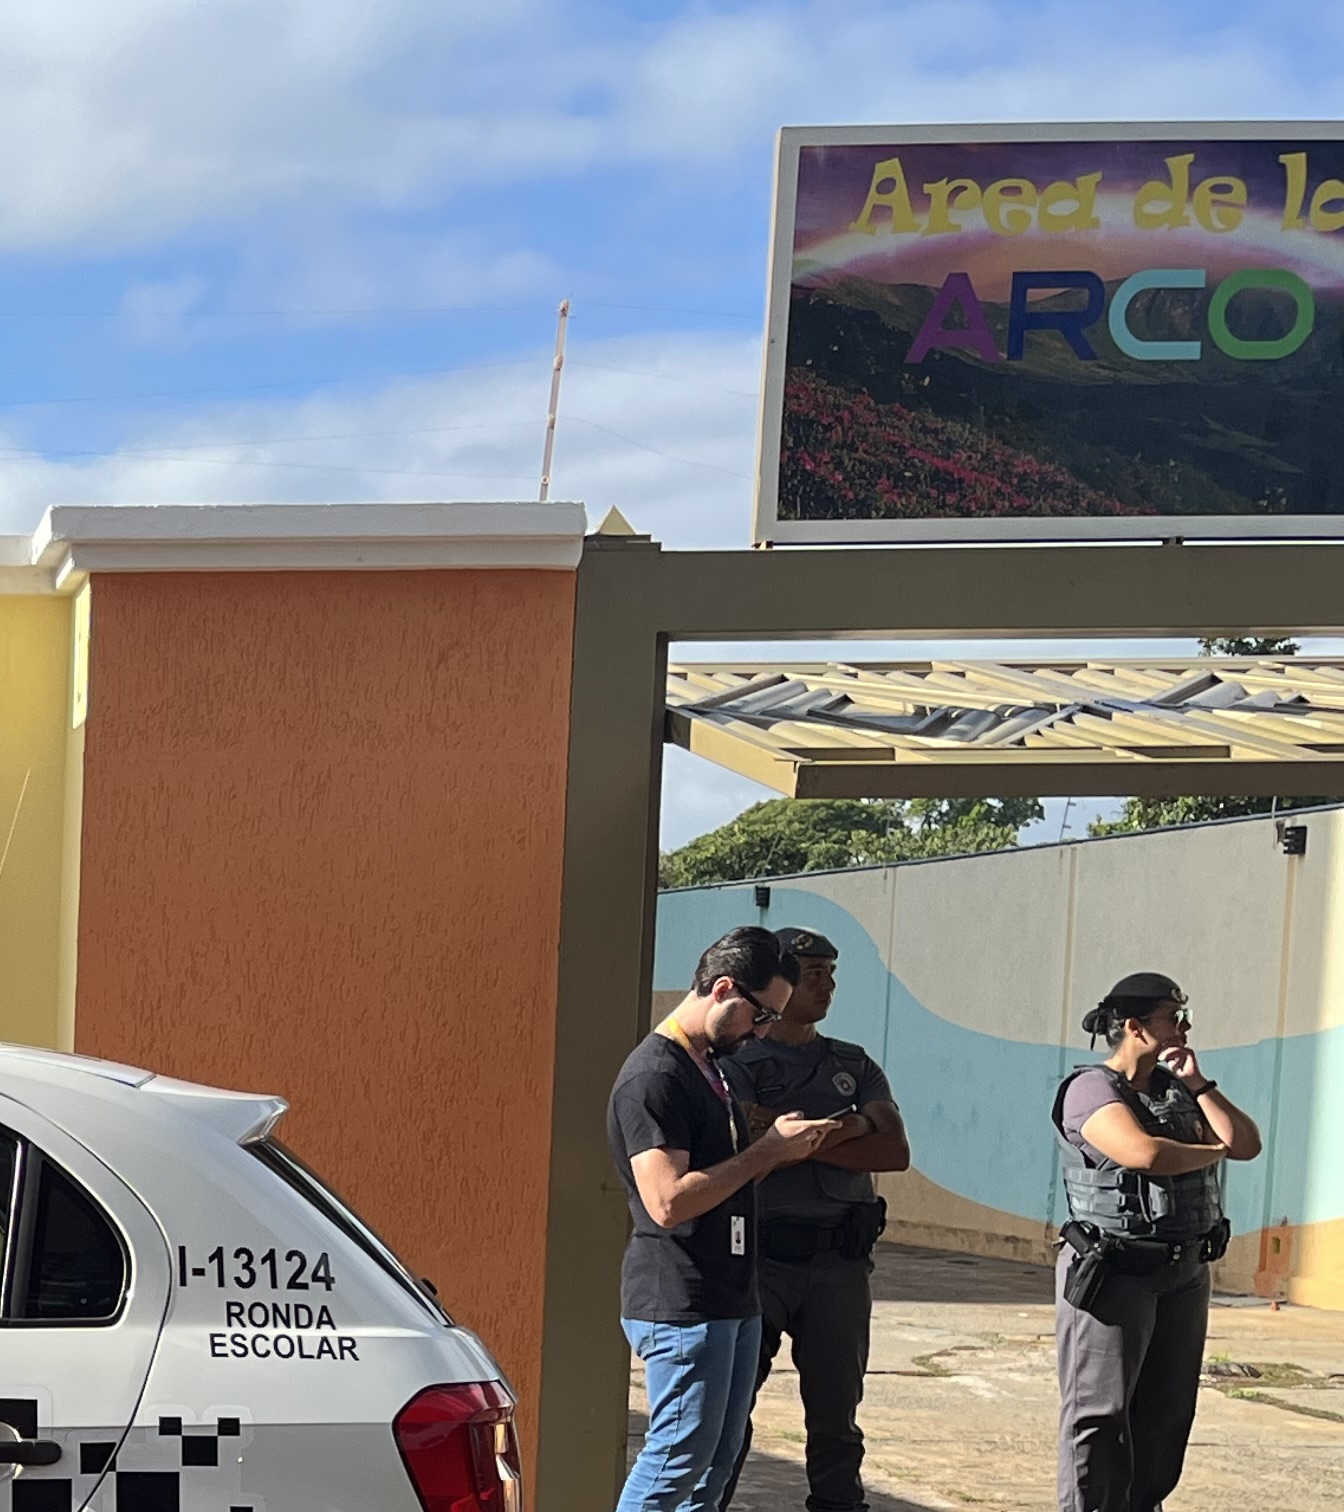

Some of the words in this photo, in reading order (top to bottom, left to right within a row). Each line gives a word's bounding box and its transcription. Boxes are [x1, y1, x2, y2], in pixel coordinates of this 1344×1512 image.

[849, 157, 1103, 236] Area
[1133, 153, 1247, 232] de
[905, 268, 1315, 363] ARCO
[178, 1246, 336, 1291] I-13124
[226, 1301, 337, 1330] RONDA
[209, 1333, 360, 1361] ESCOLAR
